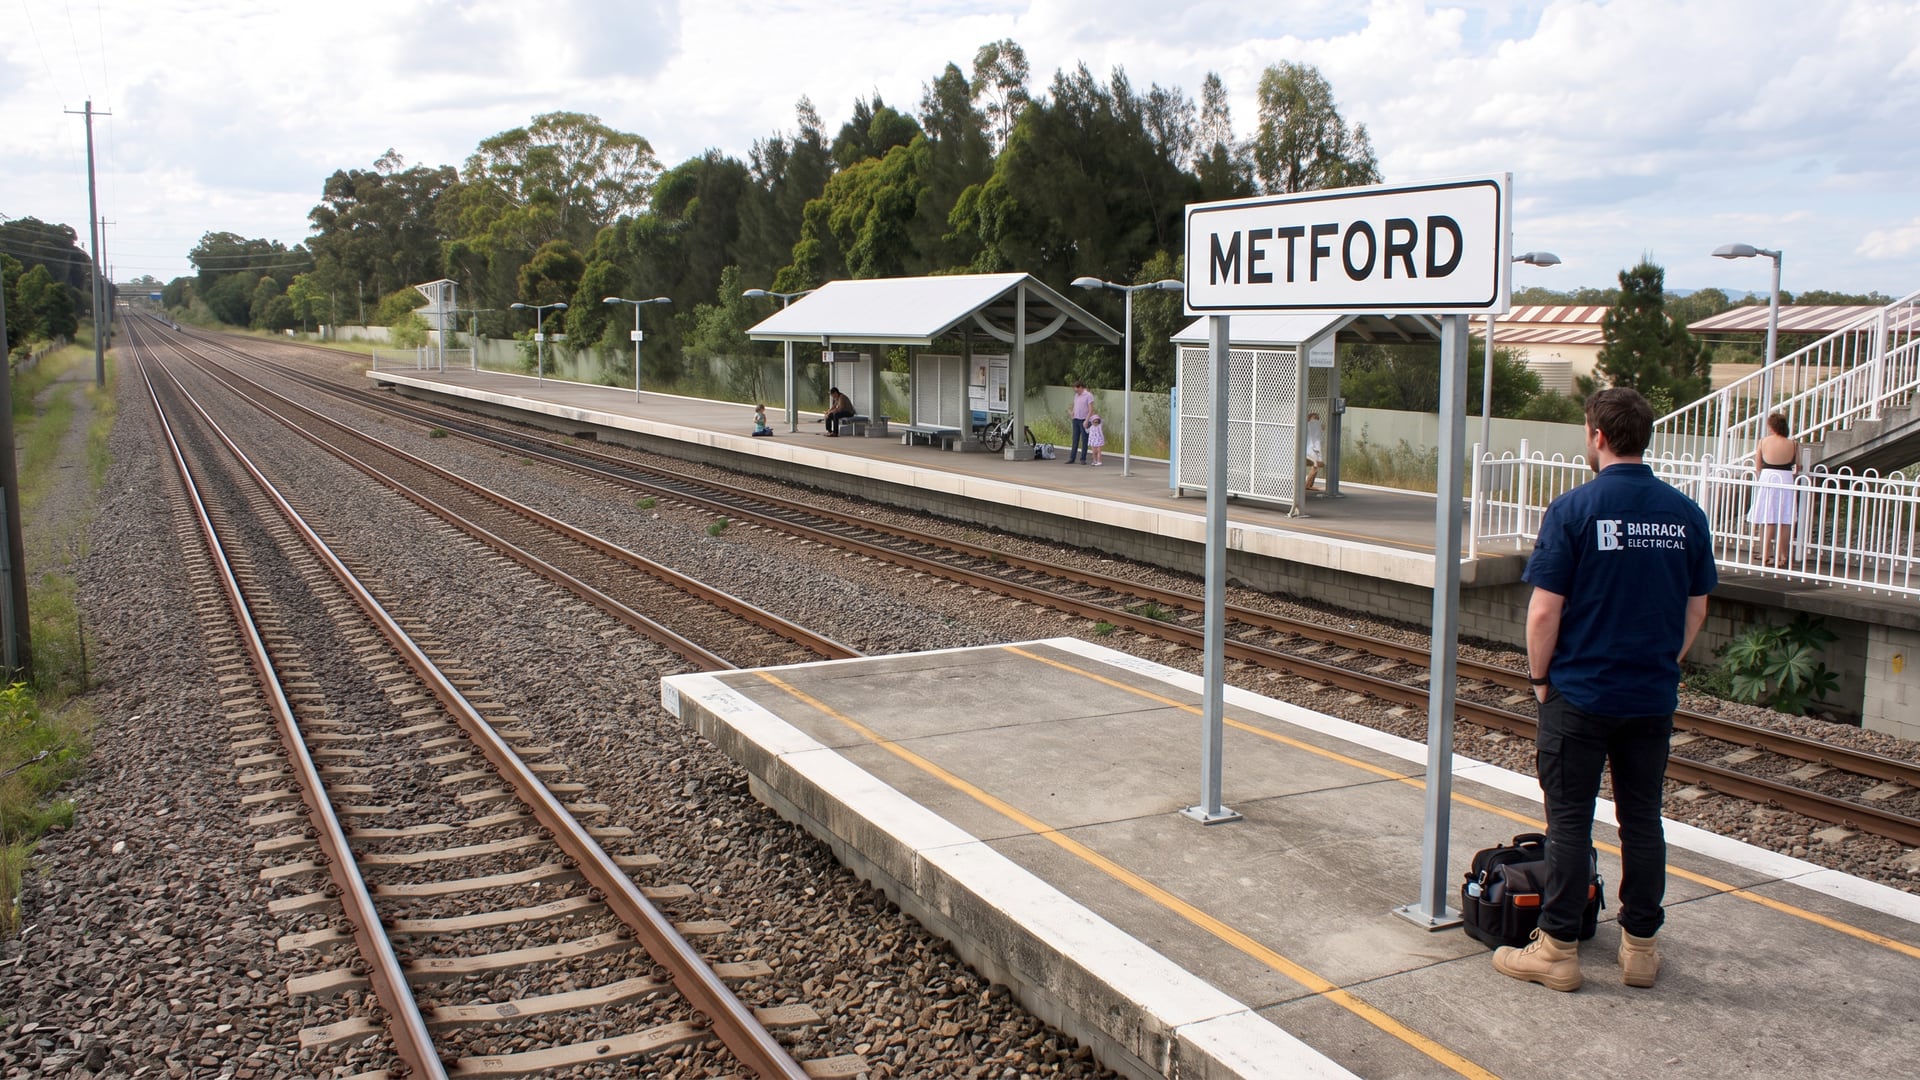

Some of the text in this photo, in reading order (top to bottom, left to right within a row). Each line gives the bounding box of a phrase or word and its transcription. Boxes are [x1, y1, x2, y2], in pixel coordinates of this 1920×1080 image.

[1210, 215, 1463, 285] METFORD
[1627, 523, 1686, 537] BARRACK
[1628, 539, 1685, 550] ELECTRICAL
